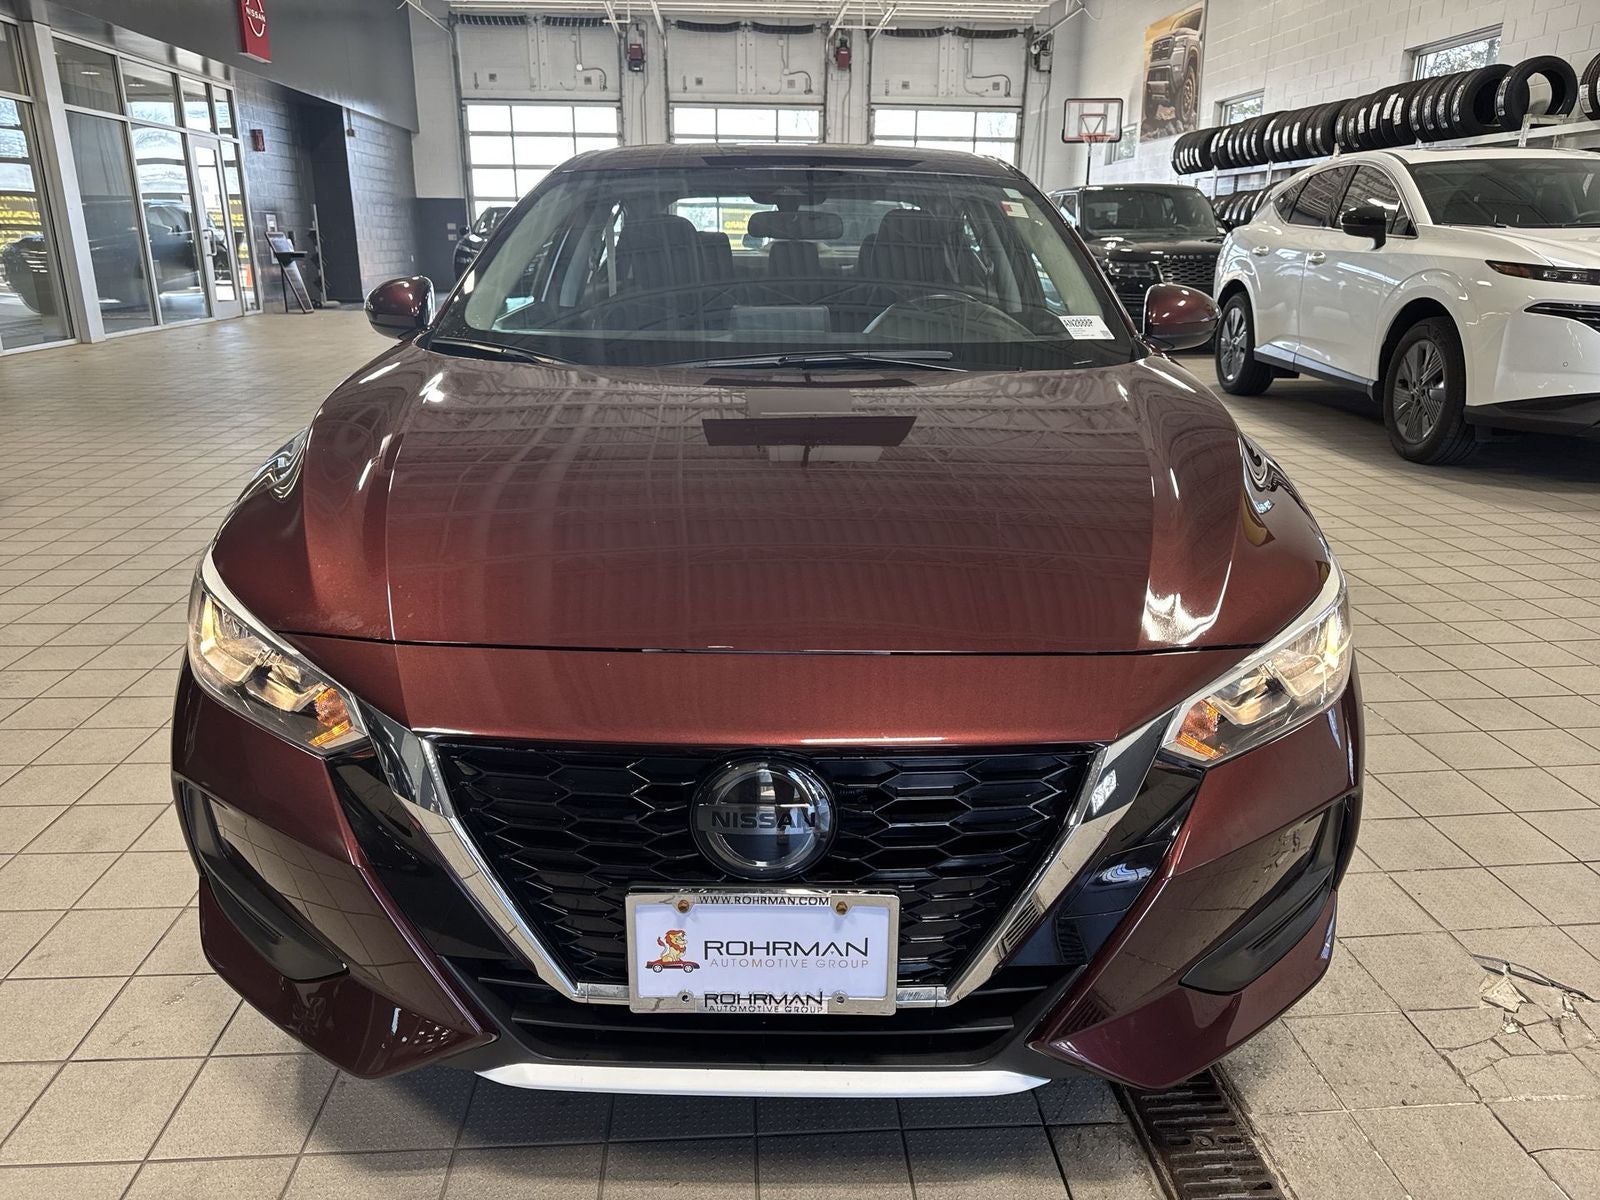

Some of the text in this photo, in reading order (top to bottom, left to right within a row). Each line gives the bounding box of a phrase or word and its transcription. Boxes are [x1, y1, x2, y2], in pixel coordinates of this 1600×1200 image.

[245, 6, 266, 22] NISSAN
[711, 811, 816, 829] NISSAN
[699, 895, 830, 906] WWW.ROHRMAN.COM
[704, 937, 869, 960] ROHRMAN
[710, 958, 869, 969] AUTOMOTIVE GROUP
[704, 991, 823, 1008] ROHRMAN
[708, 1005, 780, 1013] AUTOMOTIVE
